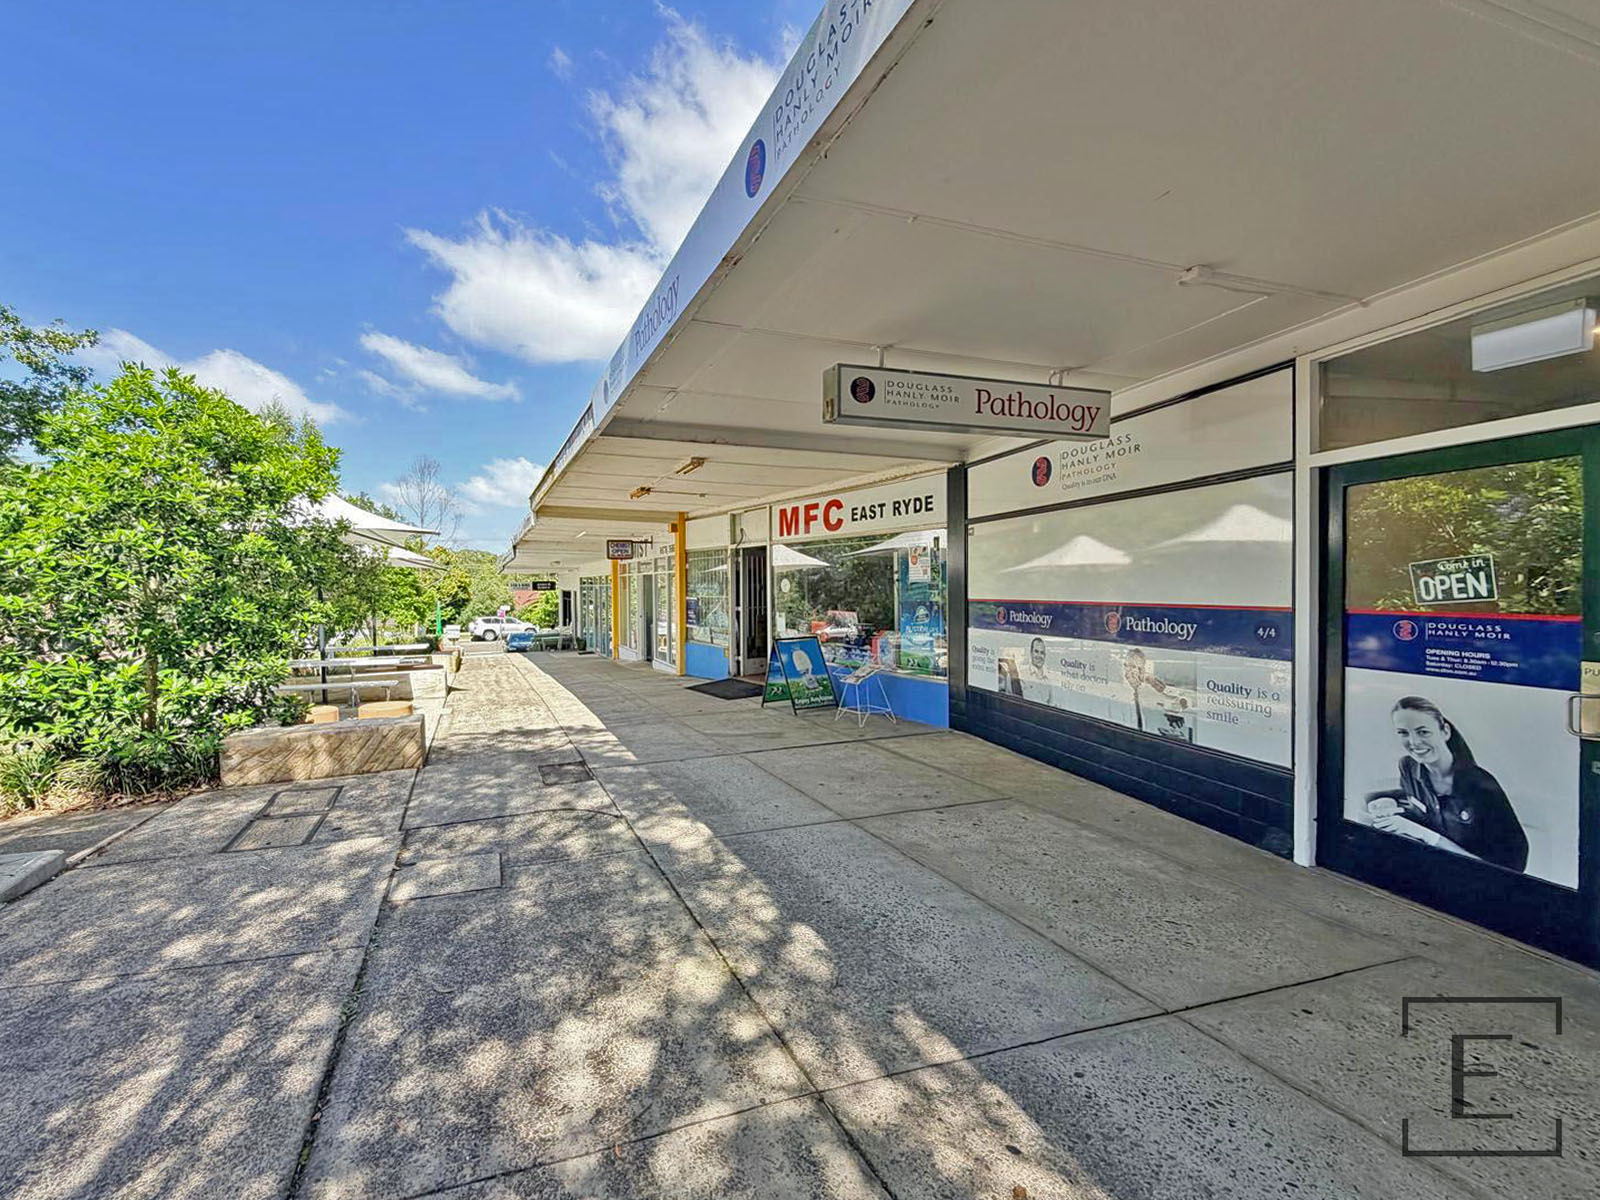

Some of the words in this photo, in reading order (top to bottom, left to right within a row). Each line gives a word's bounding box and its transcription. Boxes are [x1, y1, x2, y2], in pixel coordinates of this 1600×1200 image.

[776, 70, 818, 143] HANLY
[826, 0, 872, 68] MOIR
[776, 61, 841, 160] PATHOLOGY
[634, 274, 680, 358] Pathology
[887, 380, 953, 393] DOUGLASS
[887, 389, 924, 400] HANLY
[930, 393, 960, 404] MOIR
[975, 388, 1102, 432] Pathology
[1061, 433, 1132, 460] DOUGLASS
[1061, 454, 1099, 471] HANLY
[1105, 443, 1141, 460] MOIR
[1061, 462, 1117, 481] PATHOLOGY
[779, 499, 844, 537] MFC
[851, 503, 886, 522] EAST
[892, 495, 934, 517] RYDE
[1419, 571, 1488, 600] OPEN
[1010, 610, 1053, 629] Pathology
[1126, 616, 1197, 641] Pathology
[1428, 622, 1502, 632] DOUGLASS
[1257, 627, 1276, 638] 4/4
[1428, 629, 1469, 637] HANLY
[1474, 632, 1511, 640] MOIR
[1425, 648, 1460, 657] OPENING
[1461, 650, 1491, 659] HOURS
[1061, 658, 1087, 672] Quality
[1089, 662, 1096, 671] is
[1454, 663, 1482, 671] CLOSED
[1206, 679, 1252, 699] Quality
[1257, 687, 1268, 699] is
[1271, 692, 1281, 701] a
[1206, 695, 1272, 718] reassuring
[1206, 710, 1239, 725] smile
